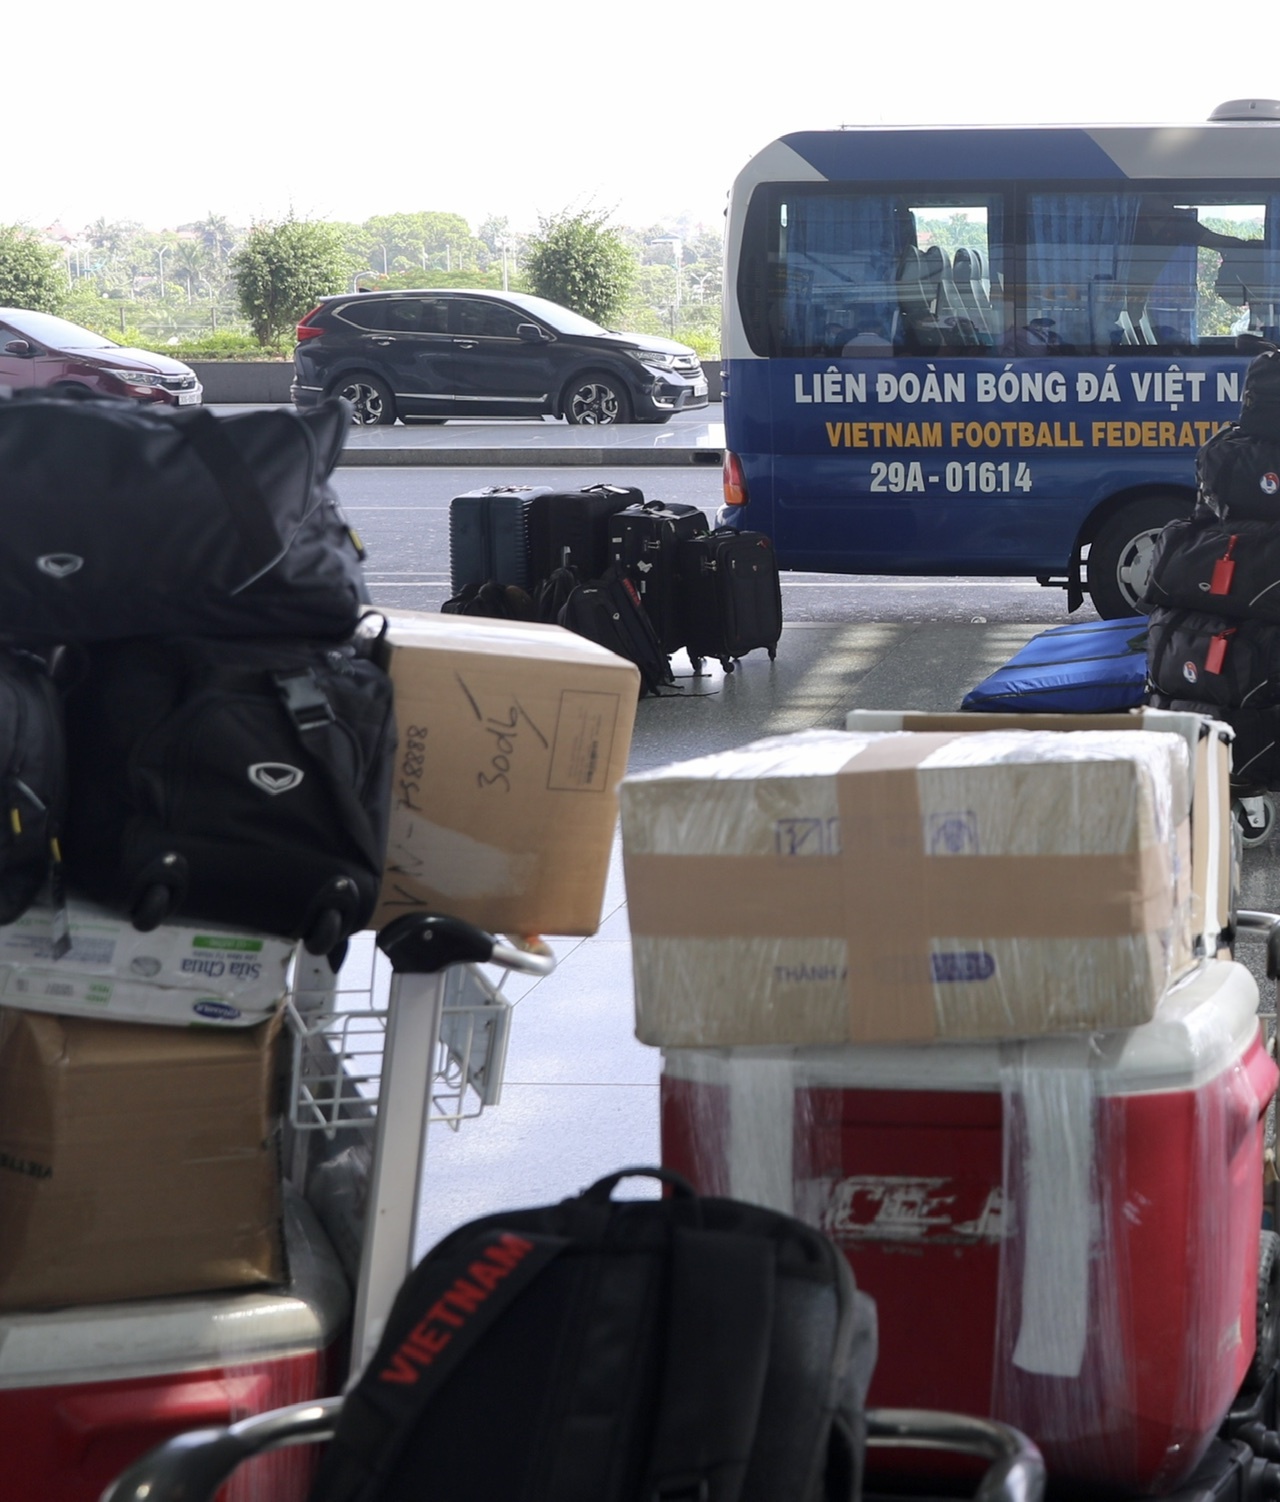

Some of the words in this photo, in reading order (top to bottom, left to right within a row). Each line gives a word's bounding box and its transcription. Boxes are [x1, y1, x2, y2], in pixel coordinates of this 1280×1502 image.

[795, 366, 867, 403] LIÊN
[876, 364, 967, 403] ĐOÀN
[977, 363, 1067, 403] BÓNG
[1077, 364, 1121, 403] ĐÁ
[1131, 366, 1206, 411] VIỆT
[1217, 372, 1243, 402] N
[825, 422, 943, 448] VIETNAM
[951, 421, 1084, 448] FOOTBALL
[1092, 421, 1231, 448] FEDERATI
[181, 959, 227, 978] Chua
[379, 1232, 534, 1385] VIETNAM
